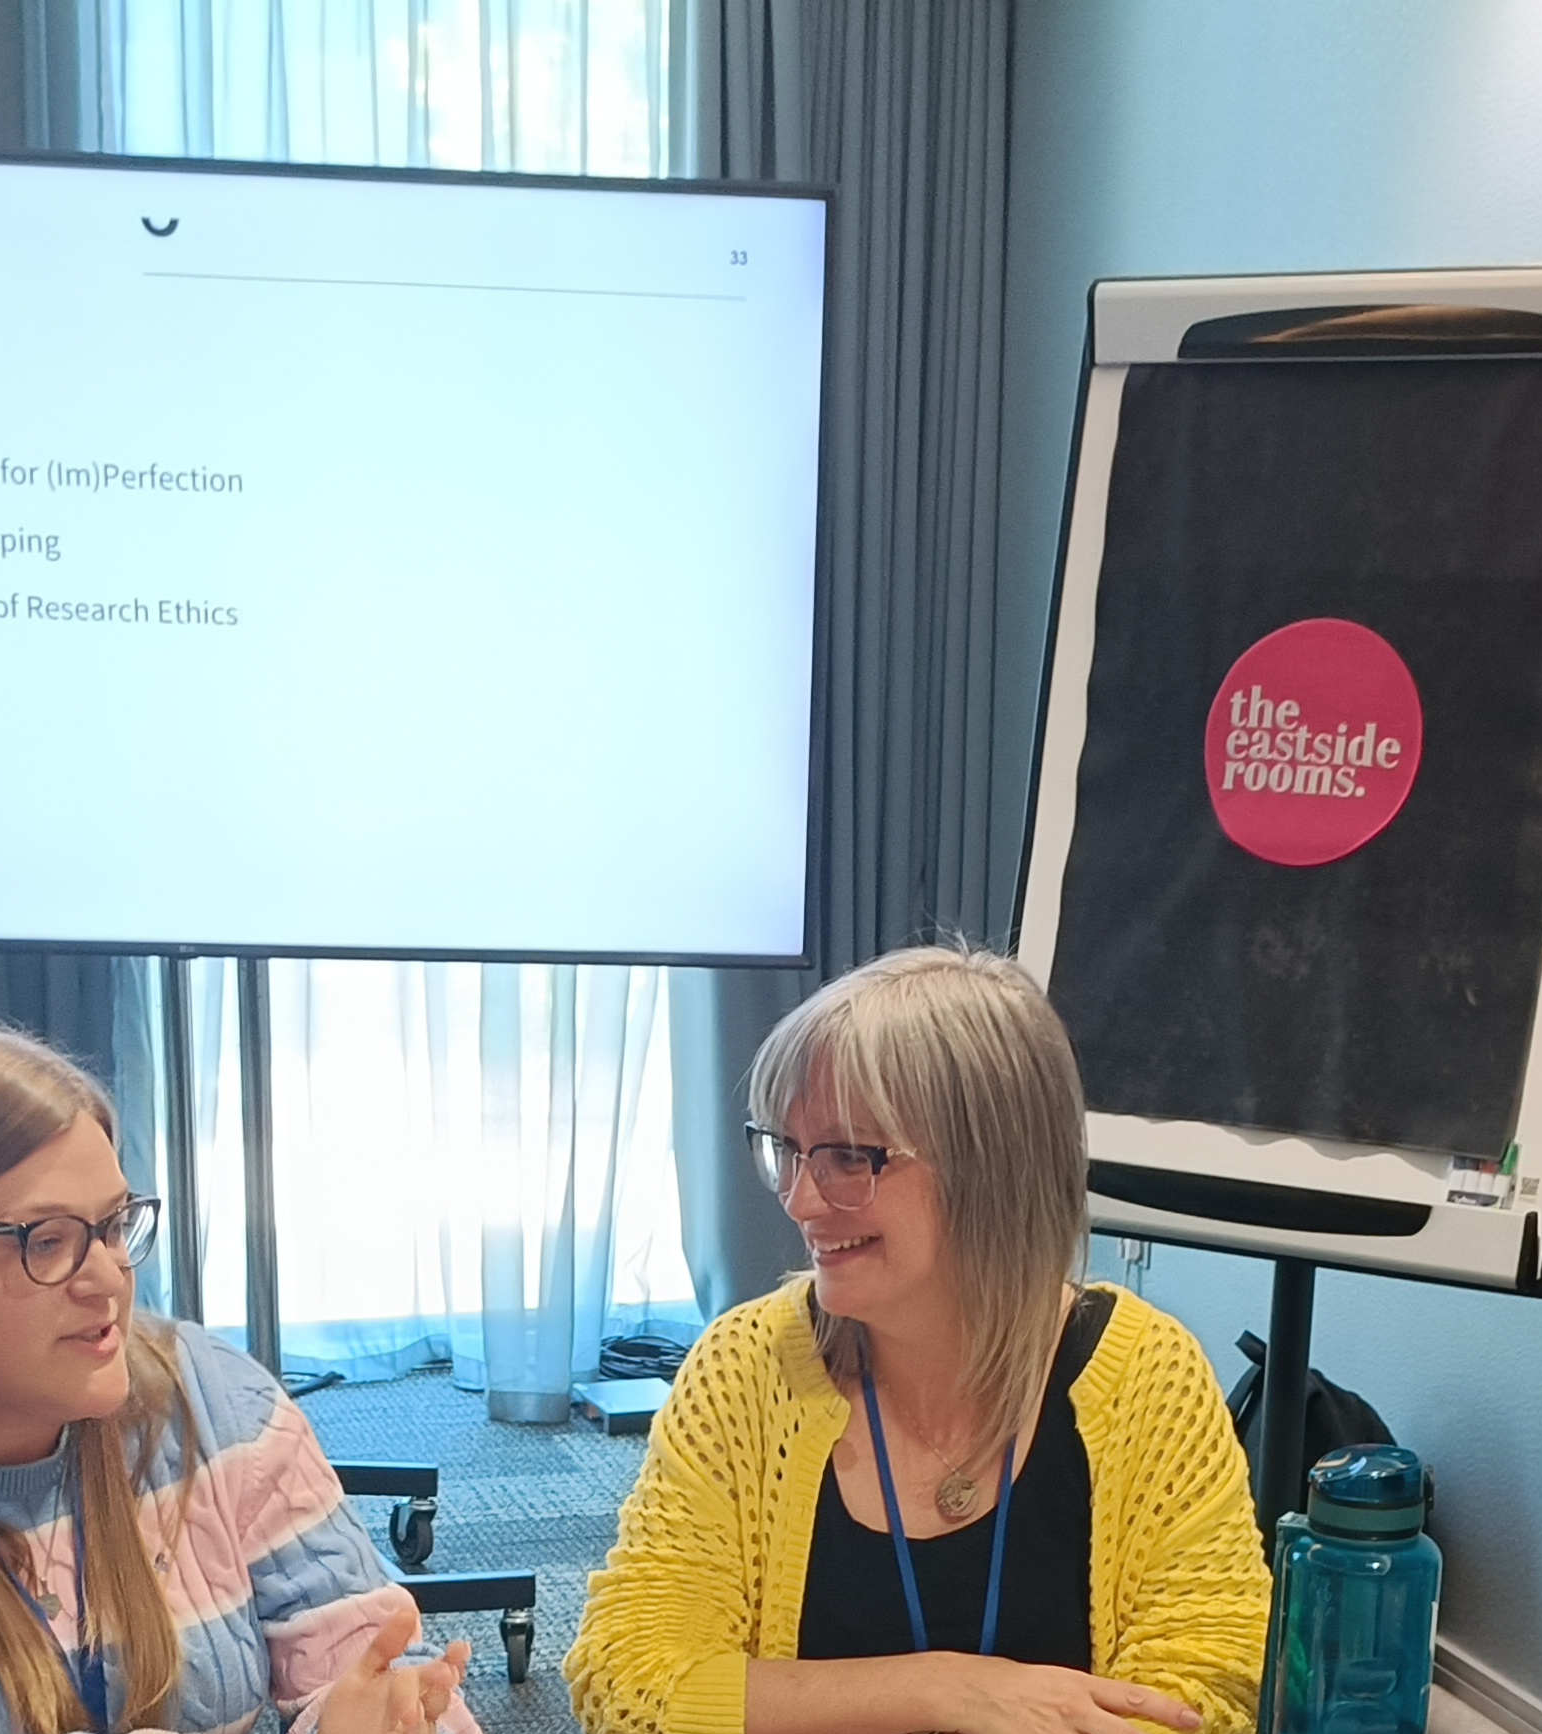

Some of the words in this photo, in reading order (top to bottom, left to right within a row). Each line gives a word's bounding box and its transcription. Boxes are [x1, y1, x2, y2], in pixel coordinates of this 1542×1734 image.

[729, 249, 748, 266] 33
[0, 457, 40, 486] for
[46, 459, 244, 494] (Im)Perfection
[26, 595, 150, 623] Research
[157, 599, 240, 627] Ethics
[1229, 684, 1301, 731] the
[1225, 722, 1402, 770] eastside
[1220, 759, 1367, 798] rooms.
